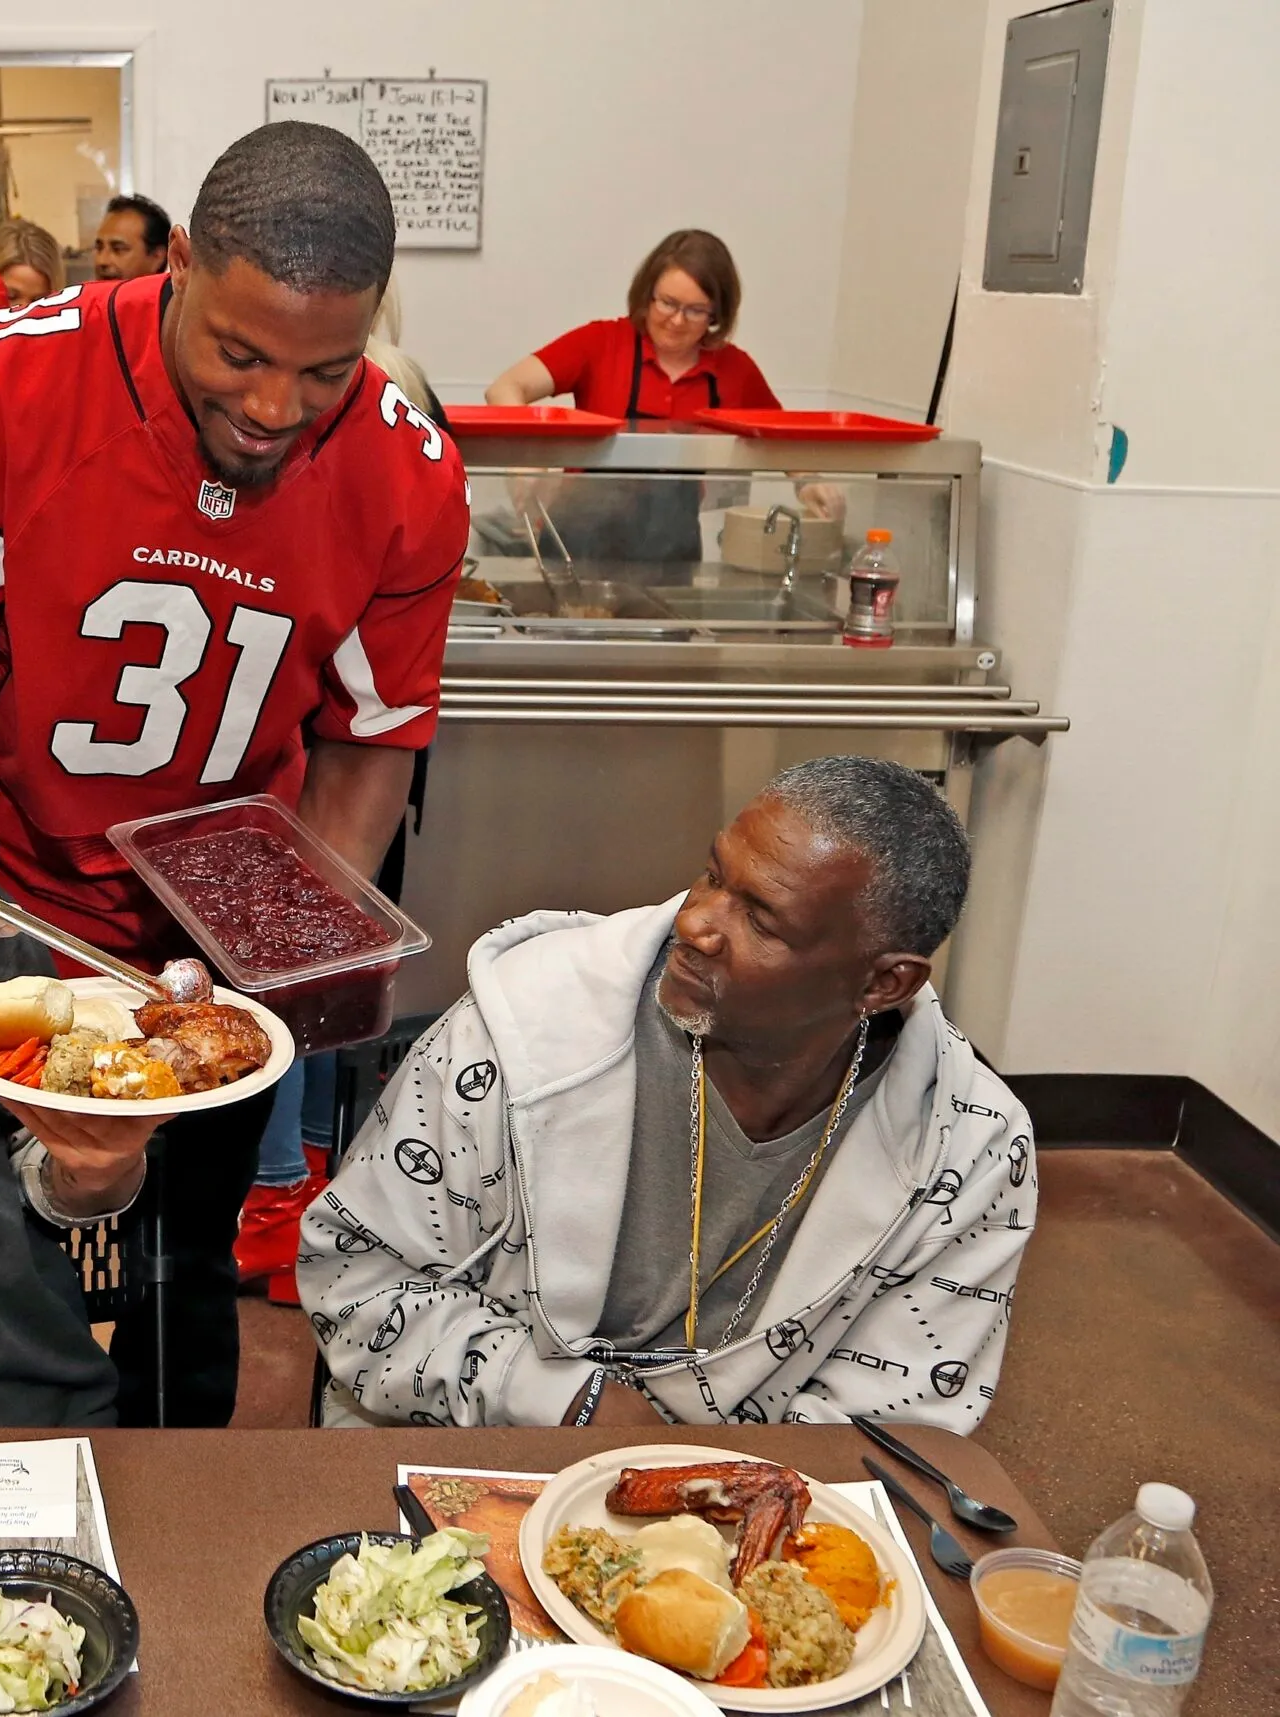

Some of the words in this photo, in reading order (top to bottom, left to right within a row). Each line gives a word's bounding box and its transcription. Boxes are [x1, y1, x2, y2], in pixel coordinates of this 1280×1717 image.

[417, 112, 436, 124] THE
[394, 205, 420, 216] ILL
[380, 380, 443, 461] 3
[202, 495, 228, 514] NFL
[132, 546, 276, 593] CARDINALS
[49, 578, 295, 785] 31
[825, 1349, 910, 1377] CION
[575, 1409, 590, 1428] JES
